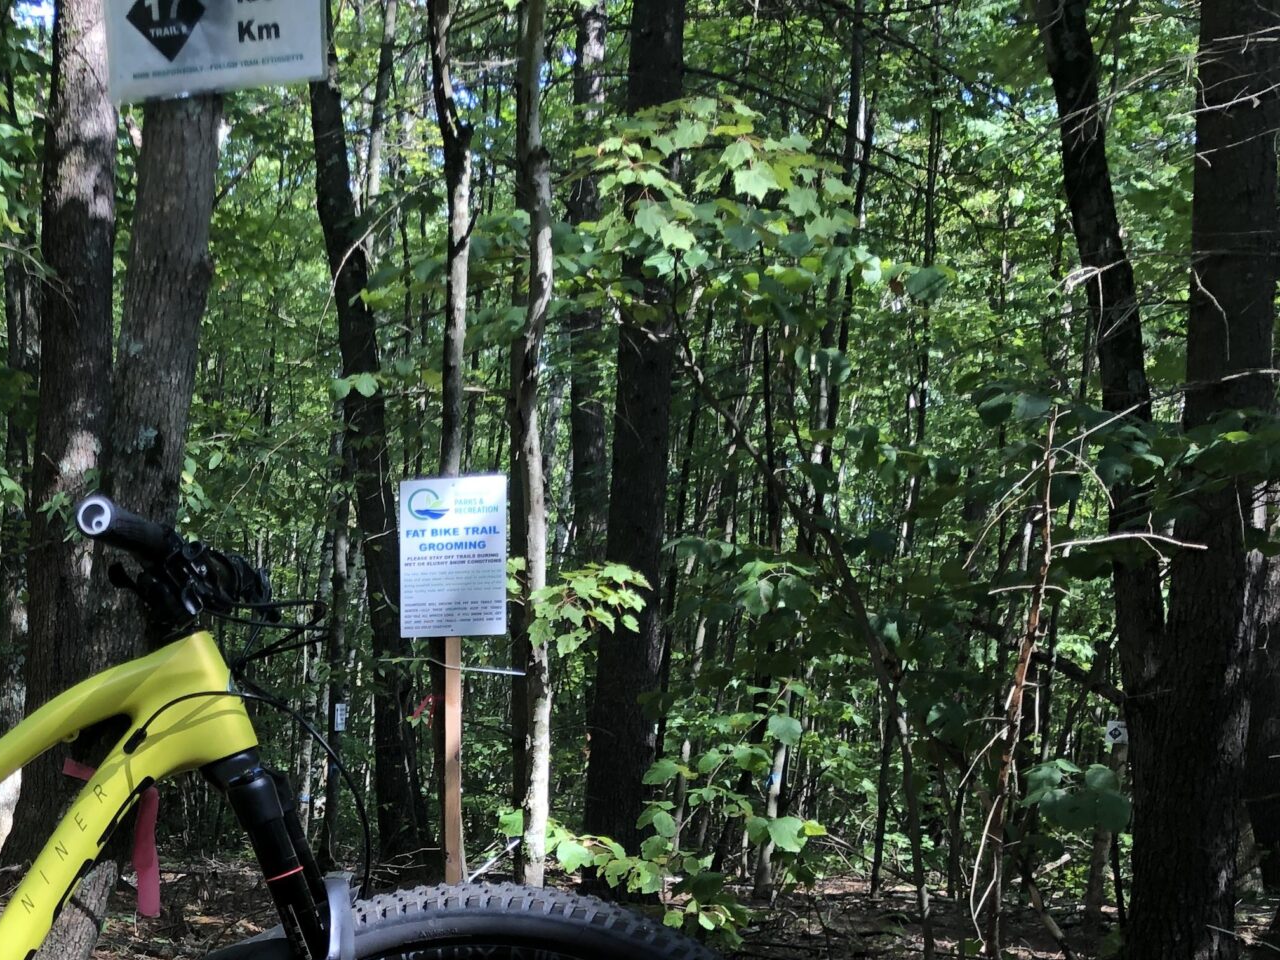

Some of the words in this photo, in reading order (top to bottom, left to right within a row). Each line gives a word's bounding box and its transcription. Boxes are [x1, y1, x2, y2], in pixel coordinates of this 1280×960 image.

[149, 25, 178, 39] TRAIL
[237, 20, 280, 43] Km
[454, 504, 499, 514] RECREATION
[406, 528, 427, 538] FAT
[431, 527, 460, 537] BIKE
[463, 525, 500, 535] TRAIL
[419, 540, 487, 551] GROOMING
[21, 784, 108, 914] NINER
